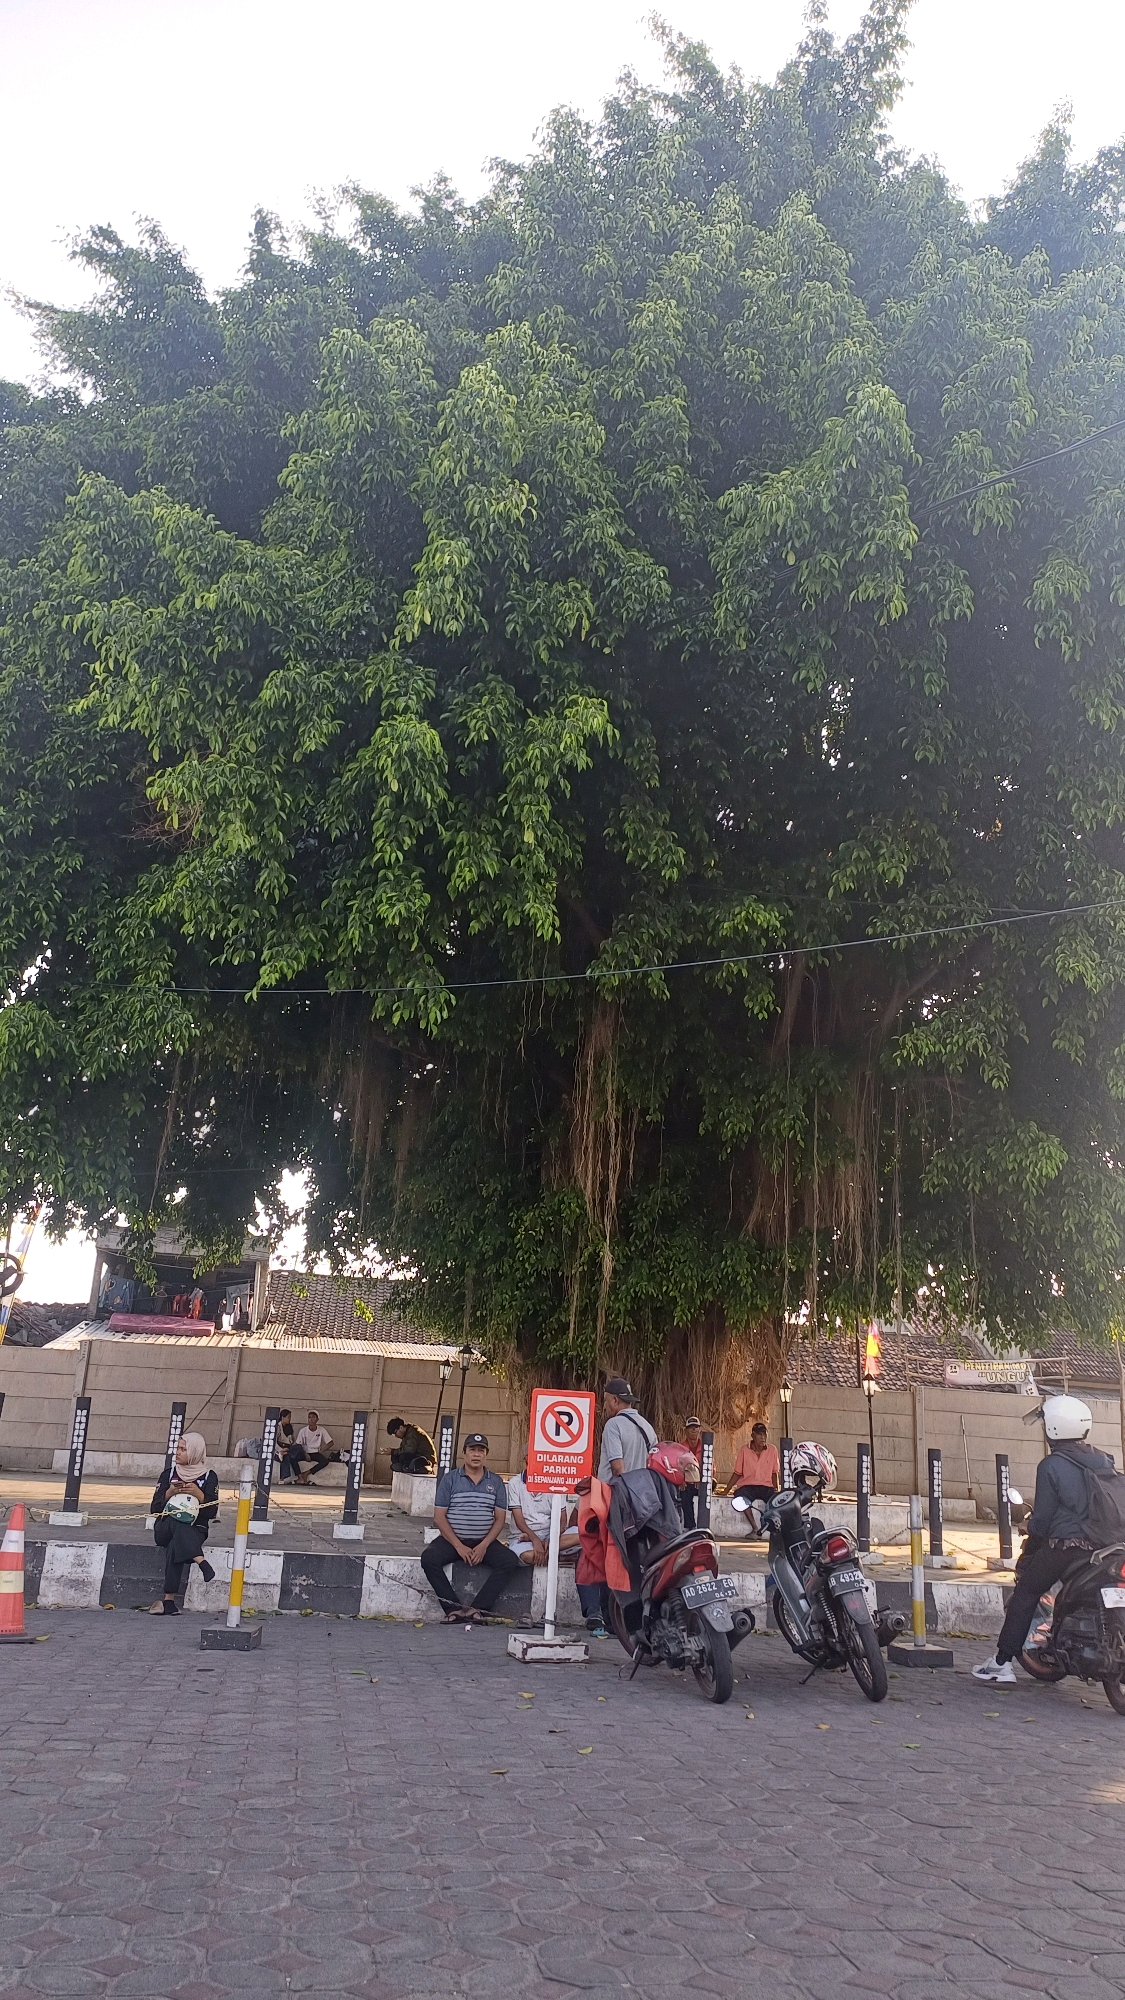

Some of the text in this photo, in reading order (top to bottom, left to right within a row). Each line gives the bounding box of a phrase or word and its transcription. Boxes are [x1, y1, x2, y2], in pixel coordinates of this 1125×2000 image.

[536, 1453, 584, 1464] DILARANG
[543, 1465, 577, 1475] PARKIR
[527, 1475, 533, 1483] DI
[534, 1476, 565, 1484] SEPANJANG
[685, 1587, 696, 1598] AD
[696, 1581, 718, 1595] 2622
